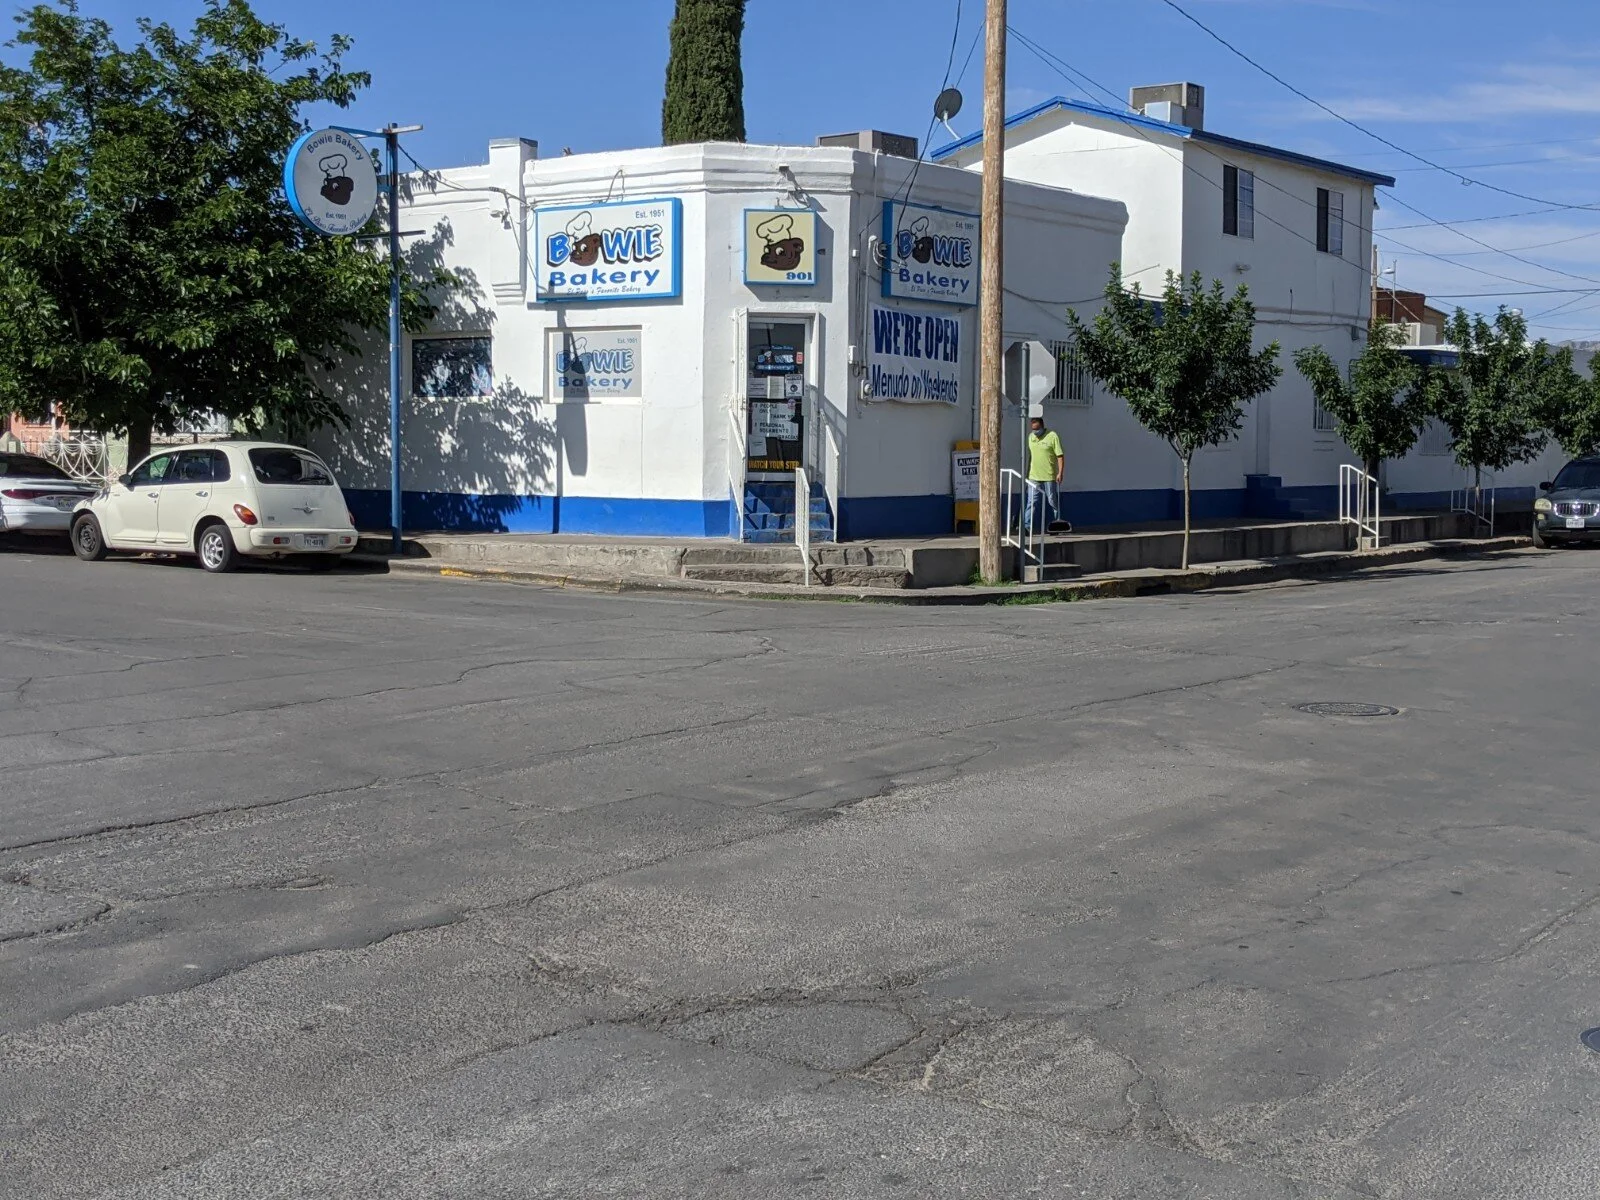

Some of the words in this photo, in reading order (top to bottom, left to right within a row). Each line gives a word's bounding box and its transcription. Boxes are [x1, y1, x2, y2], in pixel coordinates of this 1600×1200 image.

[306, 135, 333, 154] Bowie
[335, 134, 364, 161] Bakery
[635, 211, 648, 219] Est.
[649, 209, 665, 218] 1951
[550, 268, 660, 286] Bakery
[786, 272, 812, 280] 901
[900, 268, 969, 293] Bakery
[873, 309, 921, 358] WE'RE
[925, 316, 959, 363] OPEN
[559, 376, 632, 389] Bakery
[872, 364, 909, 398] Menudo
[911, 374, 922, 399] on
[921, 369, 958, 403] Weekends
[769, 461, 785, 469] YOUR
[785, 460, 800, 469] STEP
